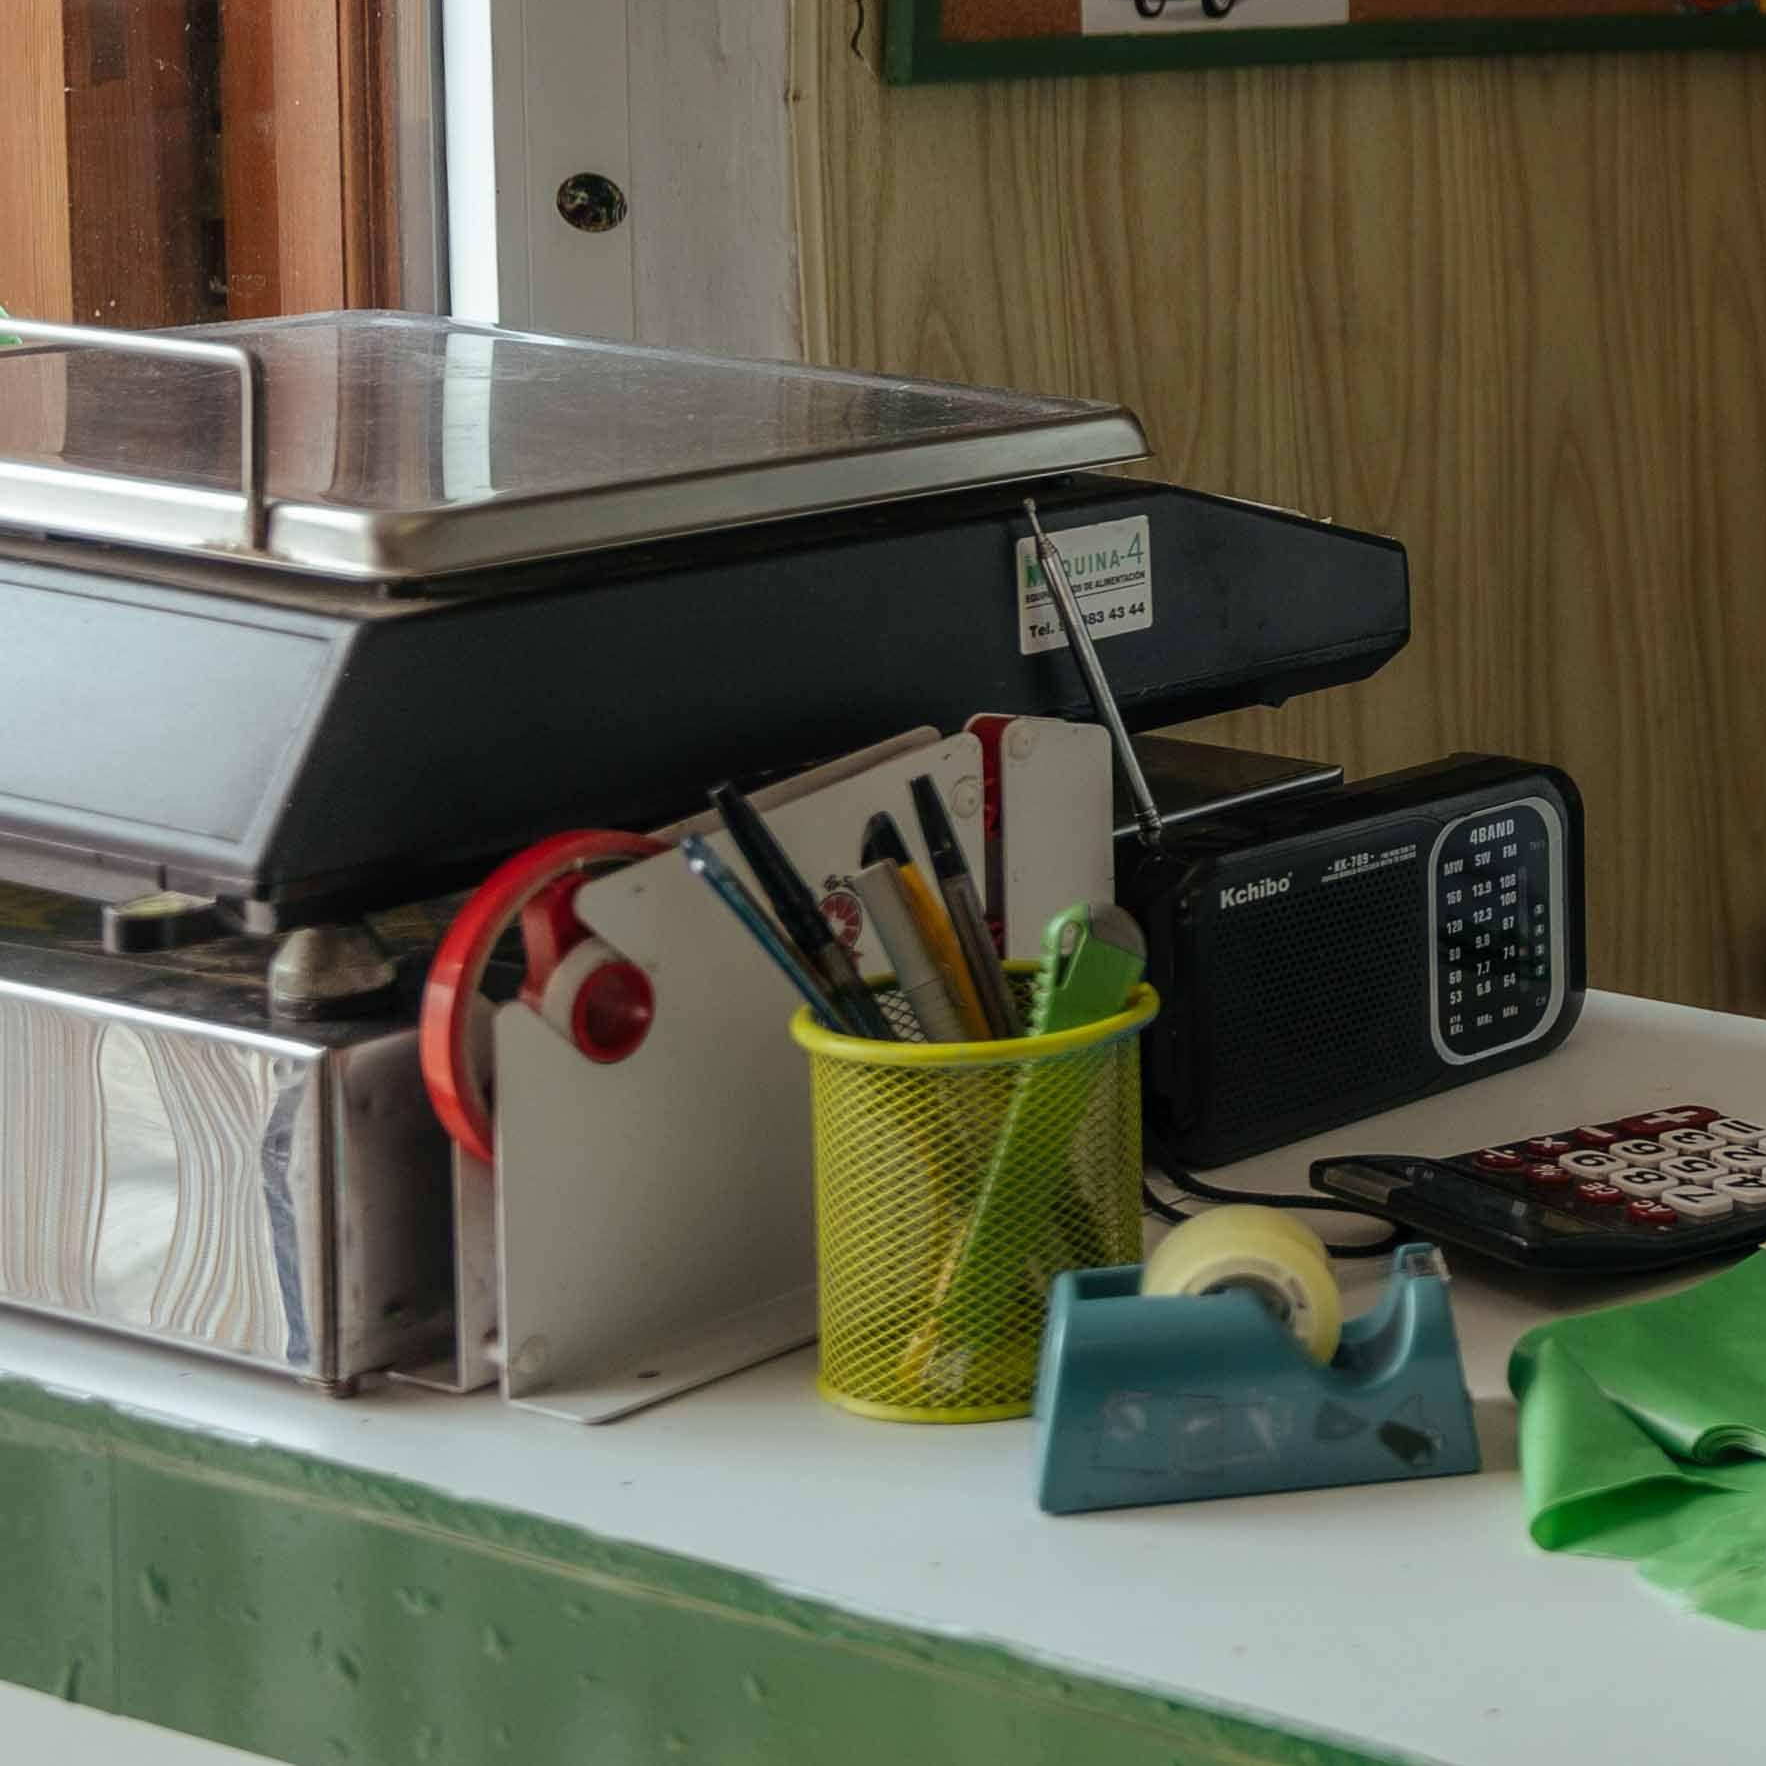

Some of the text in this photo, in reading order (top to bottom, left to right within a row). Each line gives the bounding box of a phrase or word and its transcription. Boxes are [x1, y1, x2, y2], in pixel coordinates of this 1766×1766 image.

[1024, 531, 1145, 588] MQUINA-4
[1028, 622, 1055, 639] Tel.
[1108, 606, 1126, 621] 43
[1128, 601, 1146, 616] 44
[1474, 850, 1492, 867] SW
[1502, 843, 1518, 859] FM
[1219, 875, 1291, 910] Kchibo
[1446, 918, 1463, 935] 120
[1476, 960, 1491, 977] 7.7
[1449, 989, 1464, 1006] 53
[1680, 1130, 1716, 1146] 3
[1722, 1147, 1766, 1163] 2
[1674, 1158, 1717, 1175] 5
[1623, 1170, 1667, 1186] 8
[1679, 1190, 1717, 1206] 7
